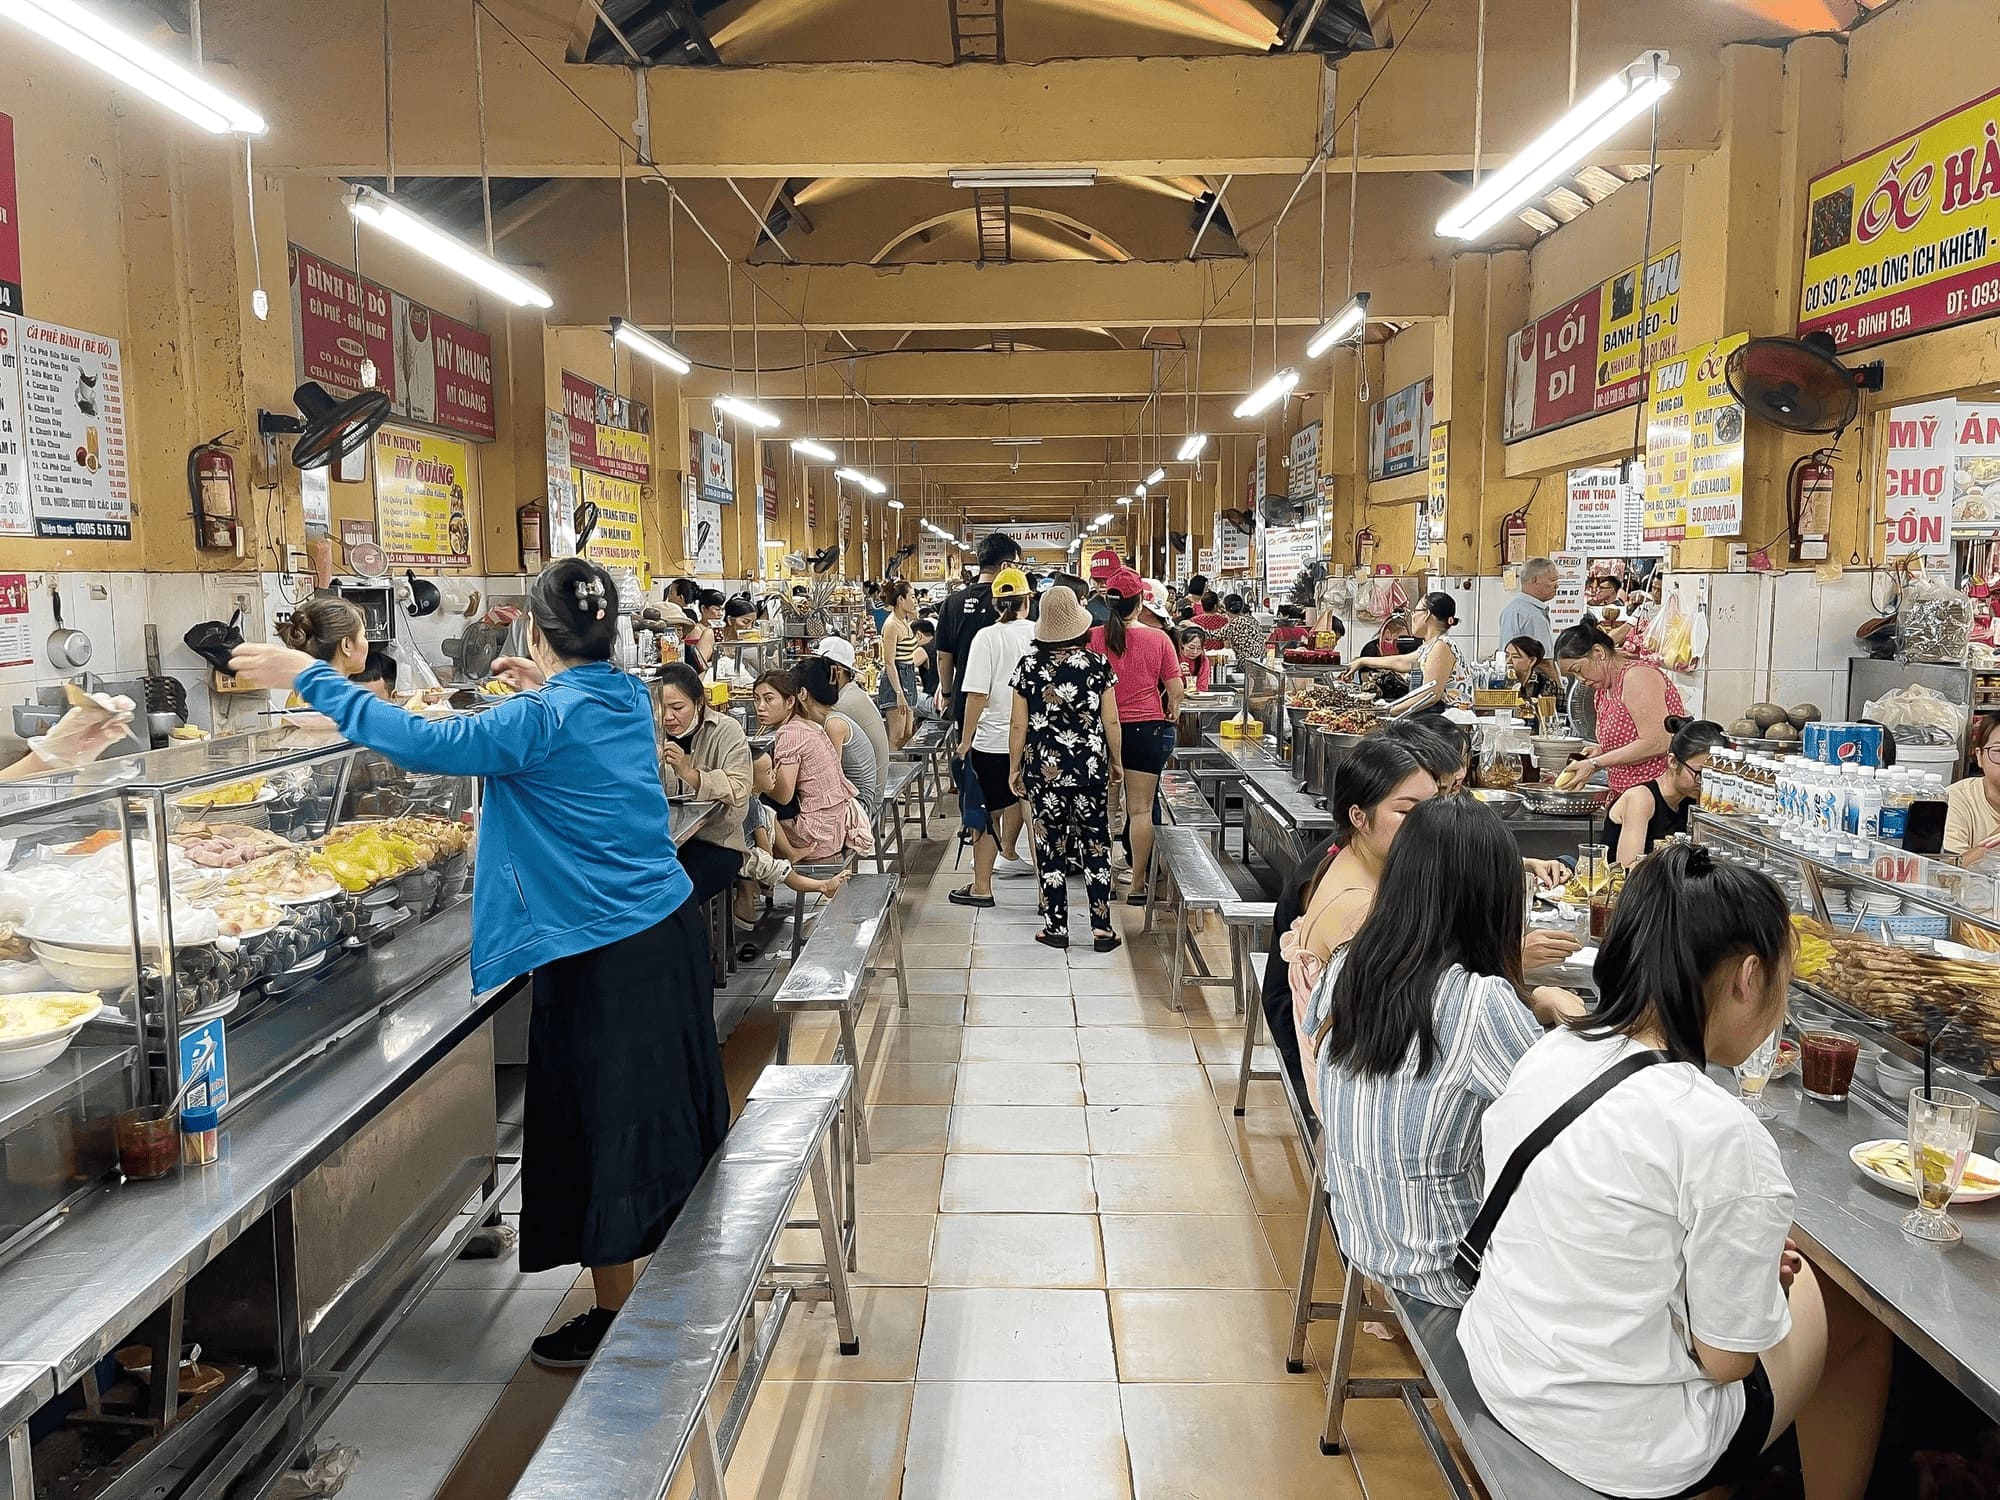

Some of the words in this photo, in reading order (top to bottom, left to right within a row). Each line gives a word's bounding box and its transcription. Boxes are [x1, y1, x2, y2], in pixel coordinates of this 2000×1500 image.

[1855, 264, 1878, 297] 294
[1912, 245, 1936, 279] ÍCH
[1544, 303, 1586, 361] LỐI
[1890, 304, 1912, 330] 15A
[455, 344, 491, 385] NHUNG
[1548, 364, 1577, 402] ĐI
[393, 435, 421, 453] NHUNG
[1888, 414, 1938, 448] MỸ
[1572, 489, 1590, 500] KIM
[1592, 489, 1617, 500] THOA
[75, 522, 96, 535] 0905
[97, 524, 112, 537] 516
[113, 524, 127, 537] 741
